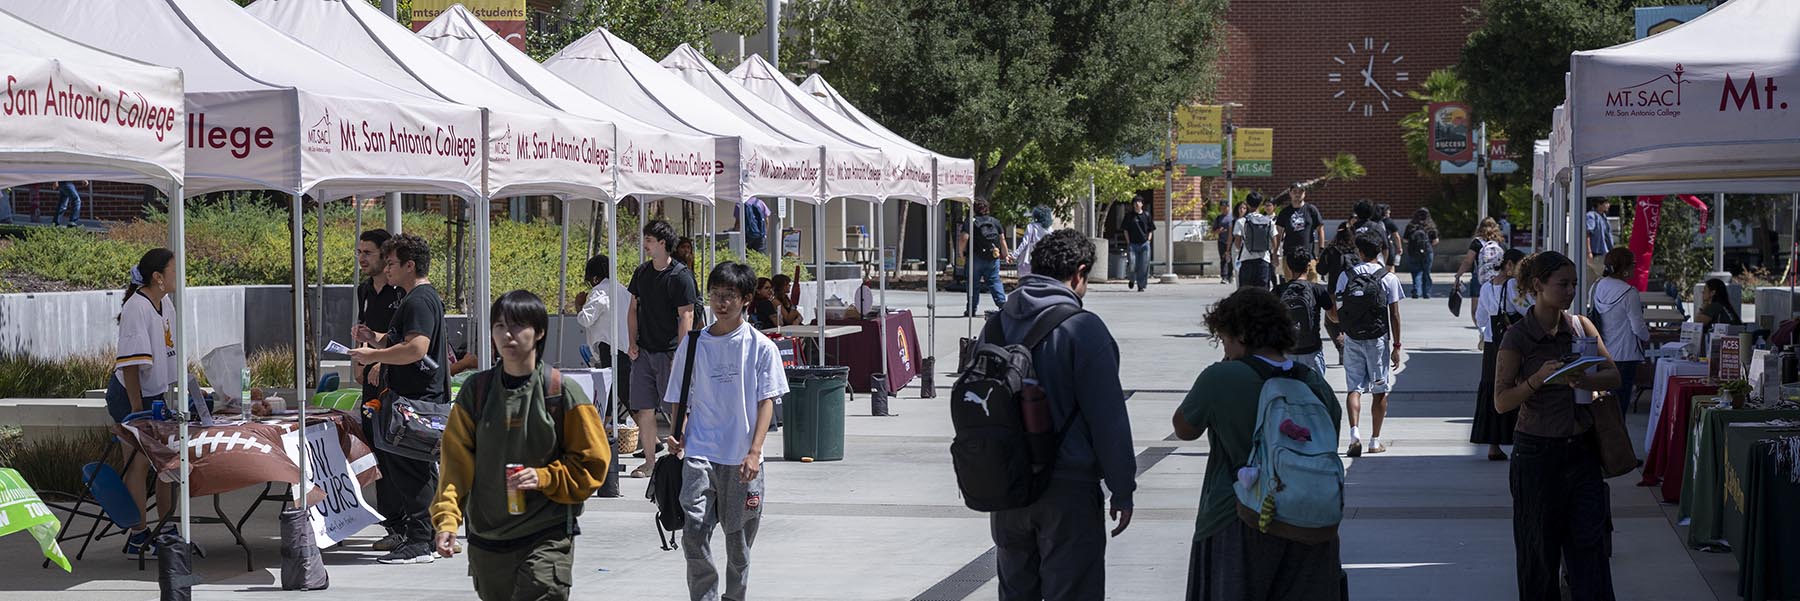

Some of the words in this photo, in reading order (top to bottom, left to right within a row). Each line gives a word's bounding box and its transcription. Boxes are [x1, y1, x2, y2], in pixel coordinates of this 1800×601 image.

[413, 7, 524, 18] mtsa/students
[3, 75, 38, 116] San
[44, 75, 110, 123] Antonio
[116, 90, 175, 142] College
[1606, 90, 1633, 106] MT.
[1637, 90, 1674, 106] SAC
[1719, 72, 1788, 112] Mt.
[1617, 109, 1629, 117] San
[1631, 109, 1655, 117] Antonio
[1656, 108, 1681, 118] College
[188, 113, 274, 159] llege
[339, 119, 361, 152] Mt.
[362, 120, 386, 152] San
[389, 121, 432, 155] Antonio
[435, 125, 476, 166] College
[517, 132, 530, 160] Mt.
[533, 132, 548, 160] San
[551, 132, 580, 162] Antonio
[581, 137, 609, 173] College
[637, 149, 649, 173] Mt.
[649, 150, 663, 174] San
[664, 151, 688, 175] Antonio
[689, 152, 712, 183] College
[1253, 163, 1271, 172] SAC
[1723, 340, 1739, 350] ACES
